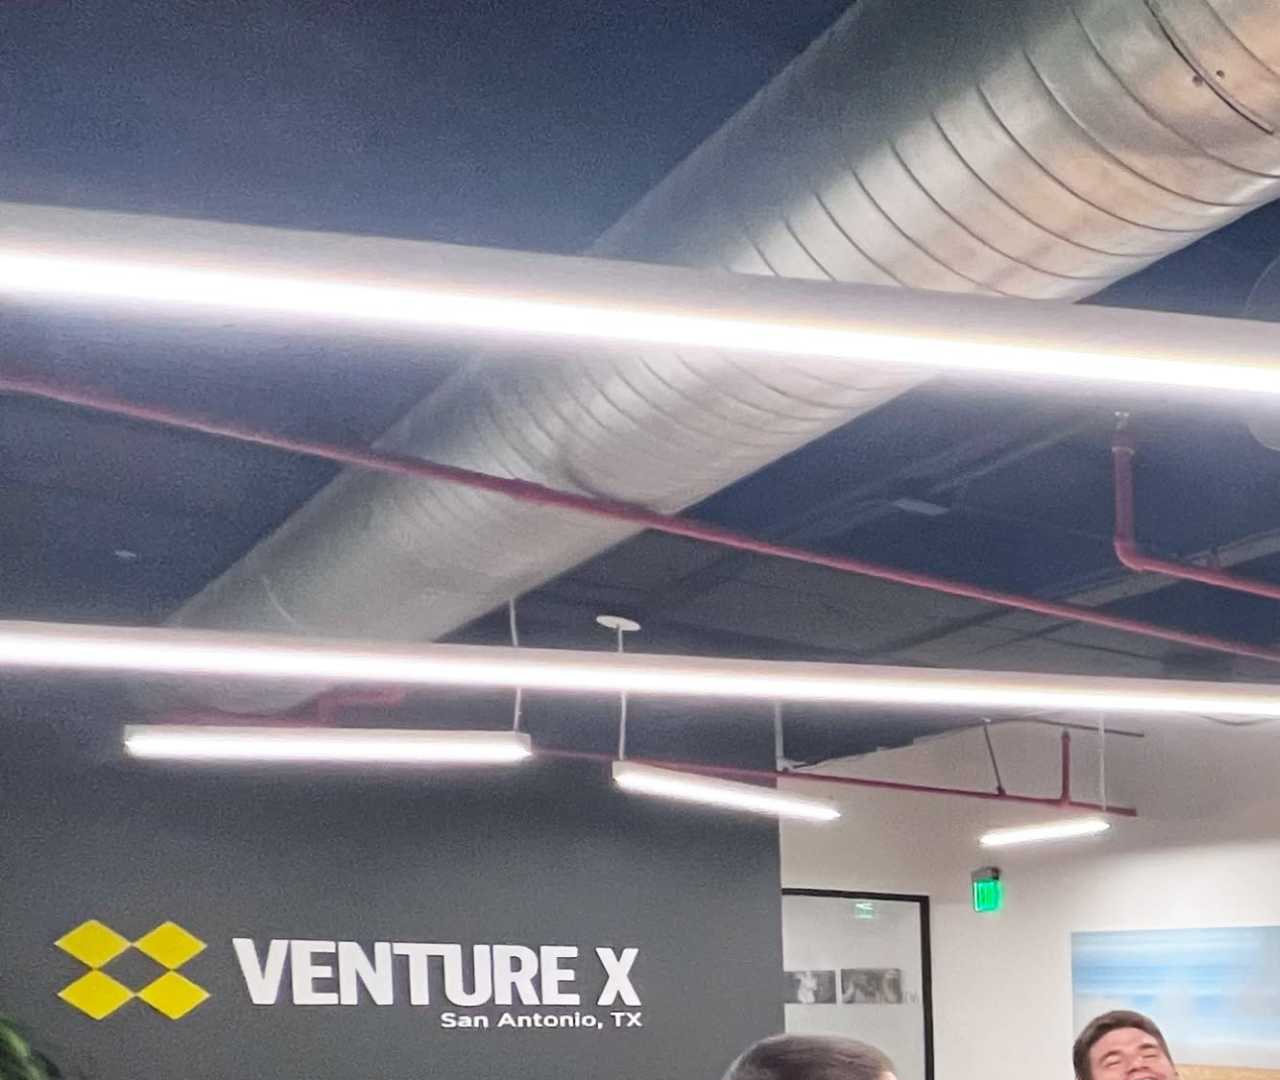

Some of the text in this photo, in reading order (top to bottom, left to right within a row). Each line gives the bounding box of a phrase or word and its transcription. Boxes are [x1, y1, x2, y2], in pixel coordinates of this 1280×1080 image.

[232, 937, 642, 1007] VENTURE X
[441, 1011, 643, 1030] San Antonio, TX
